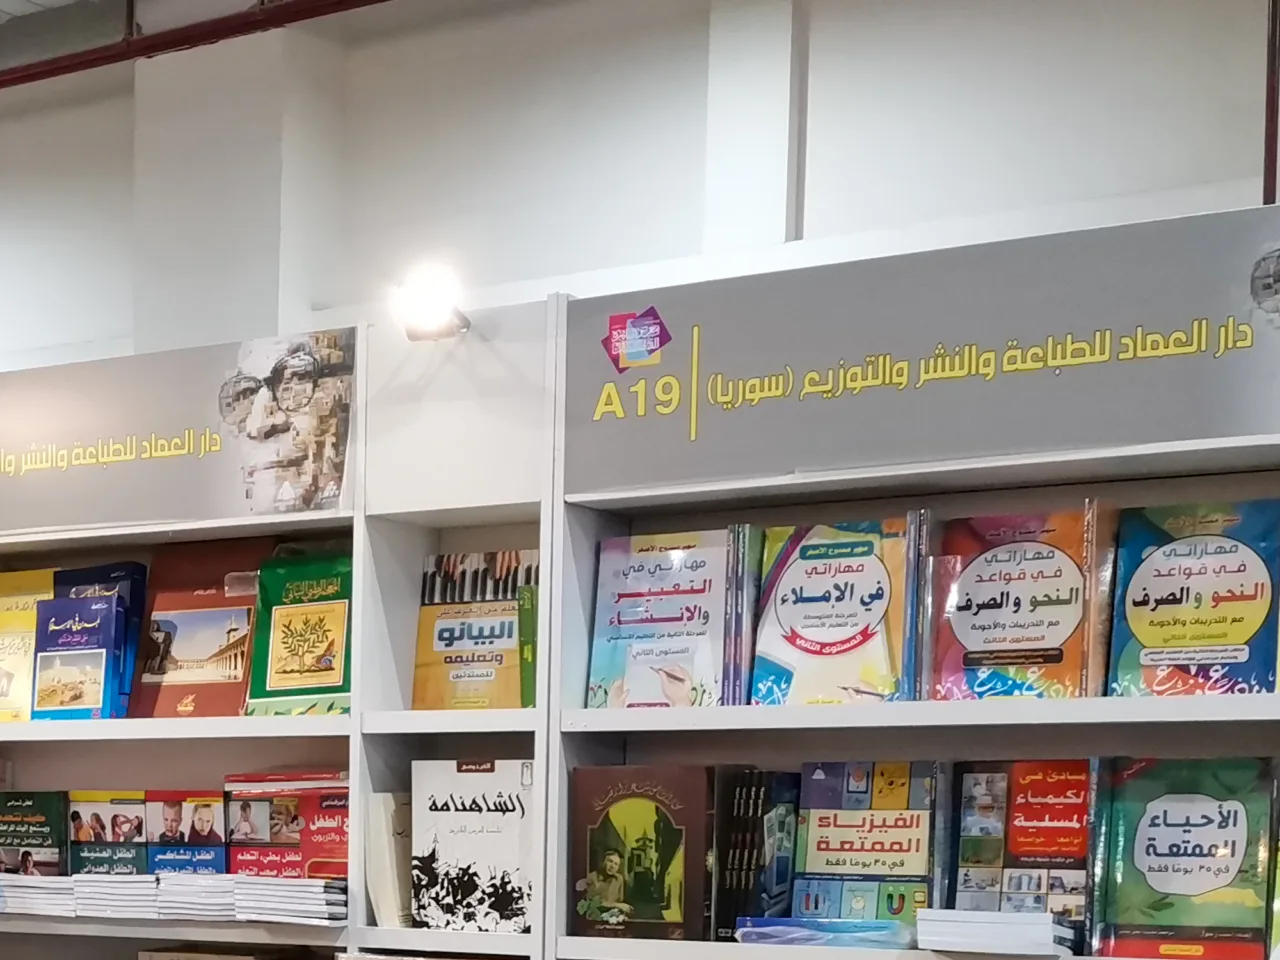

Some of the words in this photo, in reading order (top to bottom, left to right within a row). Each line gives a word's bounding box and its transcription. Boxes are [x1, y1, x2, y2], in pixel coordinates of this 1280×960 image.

[1116, 317, 1209, 362] العماد
[1212, 315, 1255, 360] دار
[1000, 329, 1113, 377] للطباعة
[913, 342, 997, 390] والنشر
[705, 364, 796, 412] (سوريا)
[800, 353, 909, 402] والتوزيع
[592, 375, 682, 421] A19
[70, 436, 137, 471] للطباعة
[140, 428, 195, 459] العماد
[196, 426, 223, 461] دار
[18, 441, 69, 477] والنشر
[984, 550, 1056, 565] مهاراتي
[1162, 541, 1240, 560] مهاراتي
[622, 562, 645, 579] في
[803, 562, 865, 579] مهاراتي
[973, 568, 1028, 586] قواعد
[1030, 566, 1063, 582] في
[1151, 563, 1209, 580] قواعد
[1211, 561, 1248, 576] في
[613, 579, 713, 605] التعبير
[780, 581, 855, 610] الإملاء
[859, 579, 885, 614] في
[1028, 586, 1080, 613] النحو
[1209, 581, 1265, 610] النحو
[608, 604, 710, 628] والإنشاء
[437, 620, 514, 648] البيانو
[821, 632, 864, 655] المستوى
[794, 636, 822, 655] الثاني
[443, 651, 504, 667] وتعليمه
[1019, 772, 1044, 785] في
[428, 791, 525, 819] الشاهنامة
[309, 814, 342, 832] الطفل
[817, 812, 921, 834] الفيزياء
[1012, 812, 1089, 832] المسلية
[1147, 804, 1239, 834] الأحياء
[79, 848, 112, 858] العنيف
[112, 848, 137, 859] الطفل
[815, 836, 921, 853] الممتعة
[1144, 836, 1237, 859] الممتعة
[192, 850, 216, 862] الطفل
[236, 850, 260, 861] التعلم
[824, 857, 847, 868] فقط
[889, 858, 906, 868] في
[110, 863, 137, 875] والطفل
[1146, 864, 1170, 874] فقط
[1213, 865, 1230, 878] في
